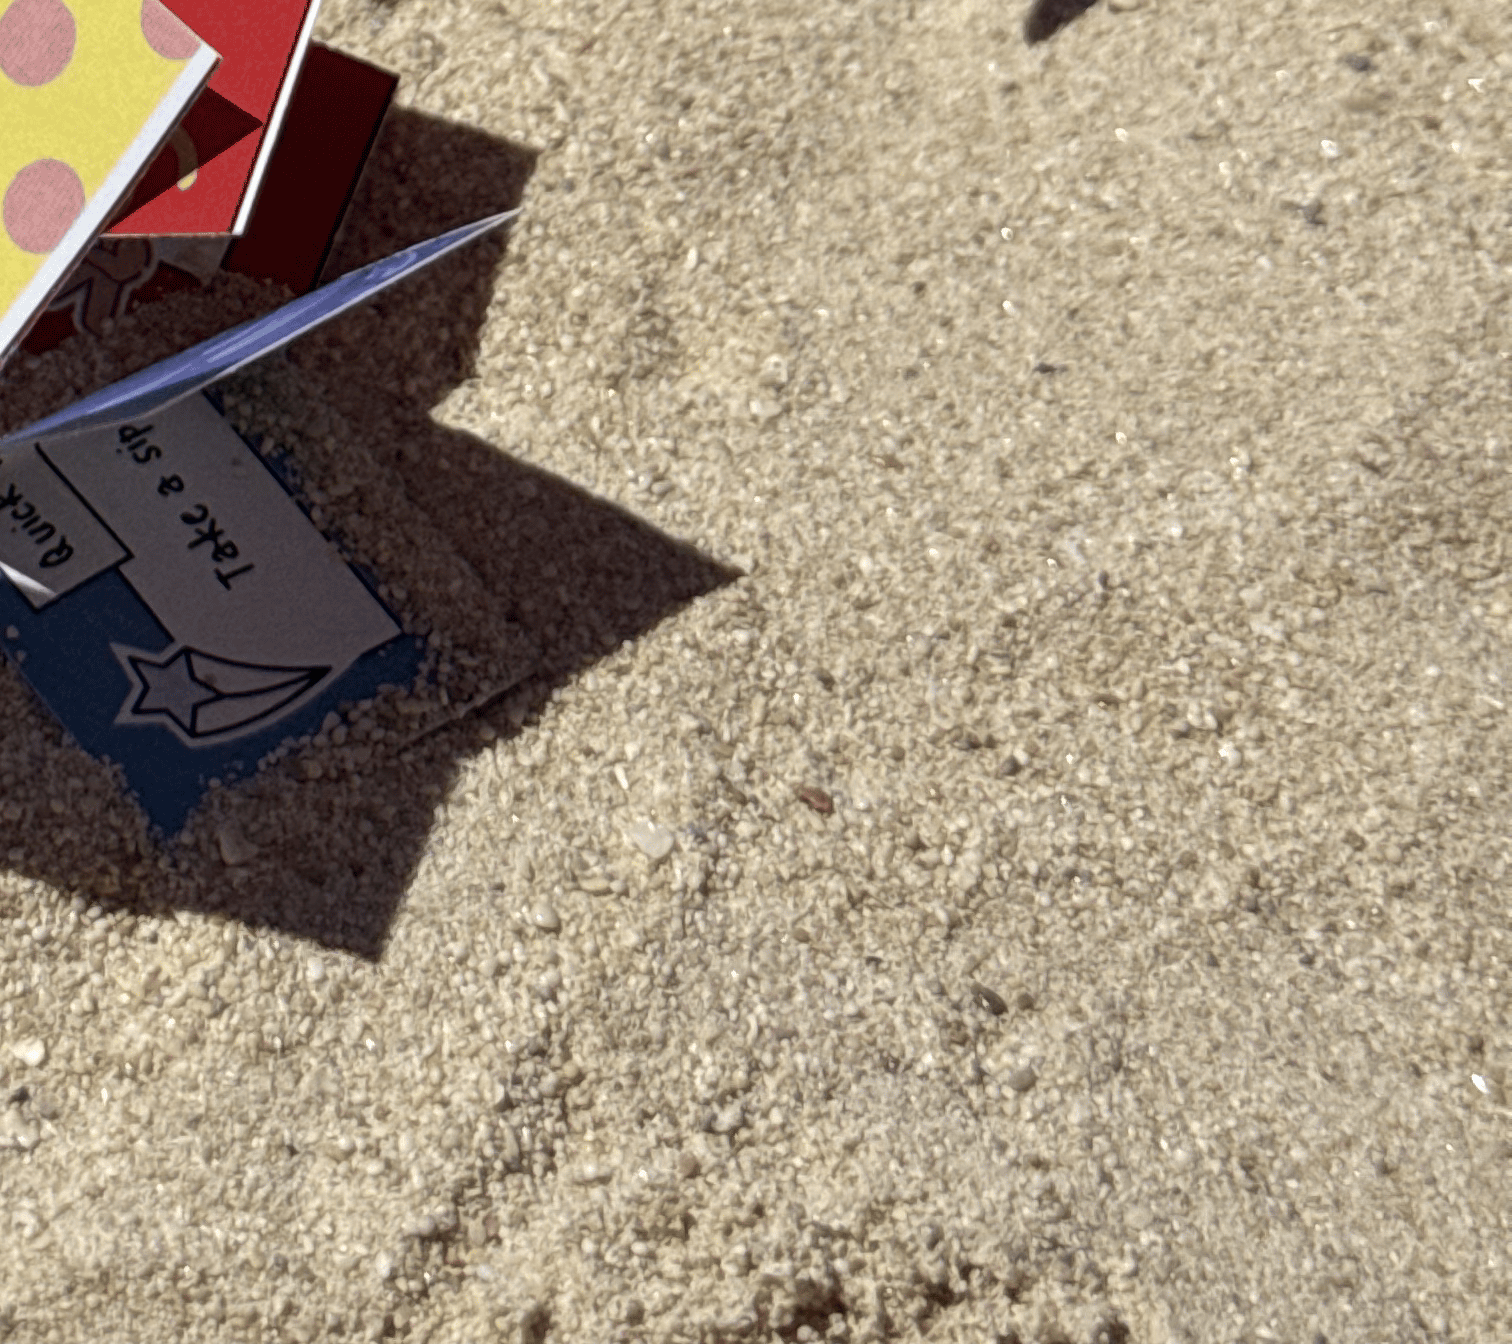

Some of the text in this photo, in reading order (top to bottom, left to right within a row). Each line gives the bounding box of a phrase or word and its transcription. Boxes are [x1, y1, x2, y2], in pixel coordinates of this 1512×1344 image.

[115, 422, 256, 591] Take a sip
